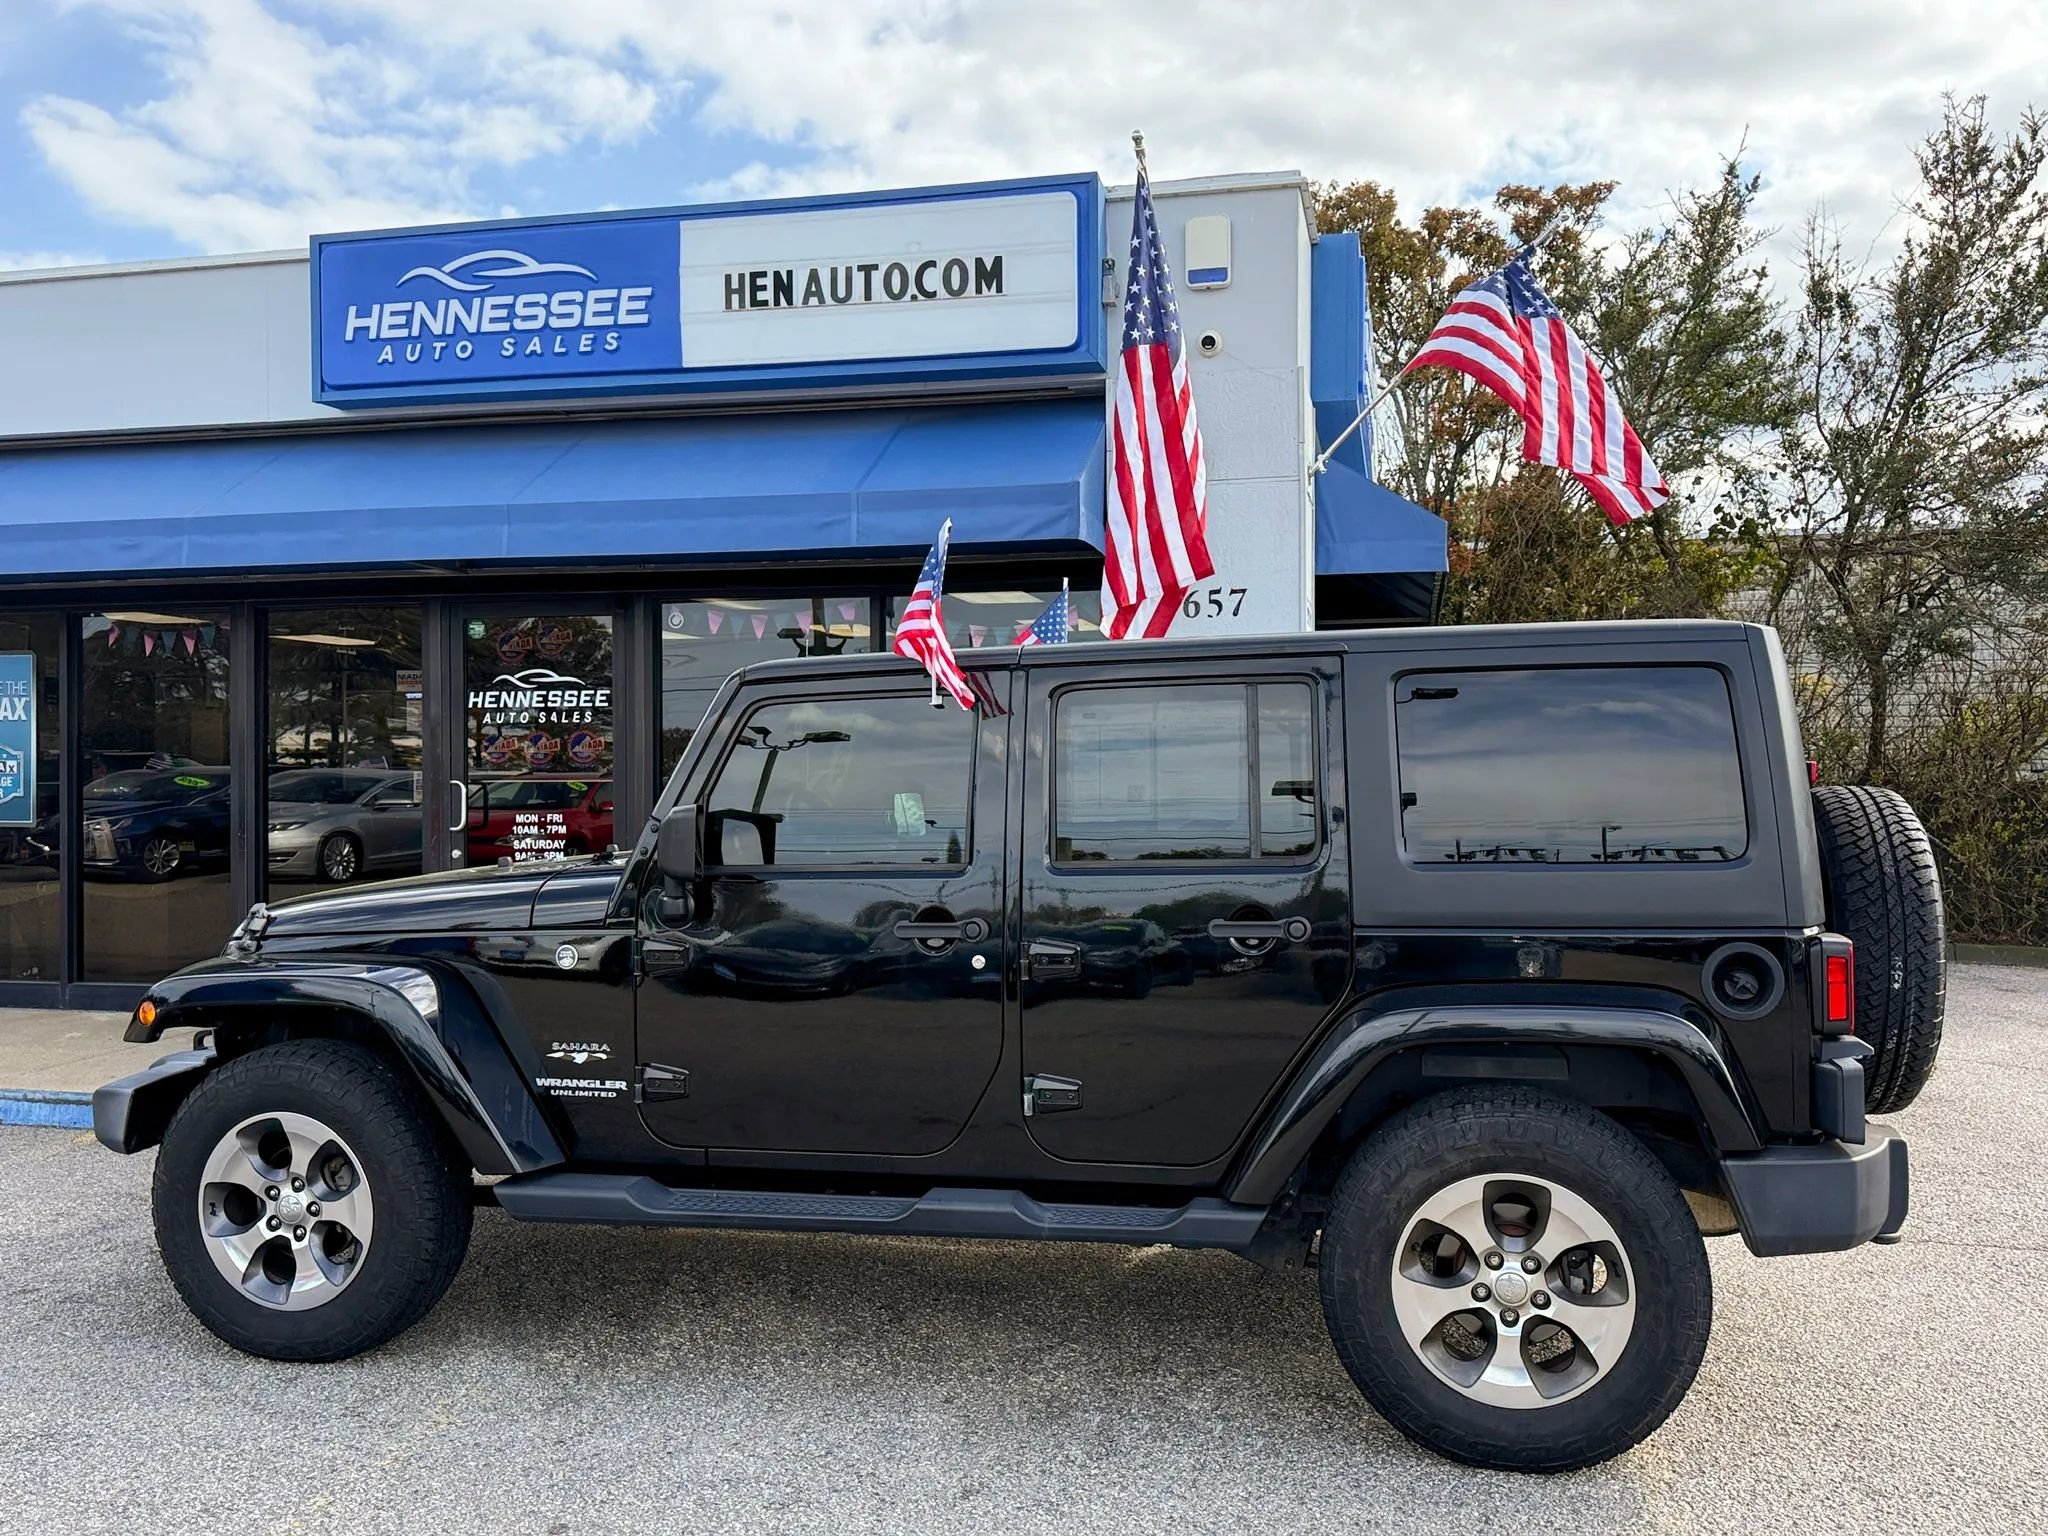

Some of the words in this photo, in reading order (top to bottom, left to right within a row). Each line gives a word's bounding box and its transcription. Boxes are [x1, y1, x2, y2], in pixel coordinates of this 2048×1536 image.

[723, 255, 1004, 310] HENAUTO.COM
[344, 286, 653, 342] HENNESSEE
[377, 339, 474, 364] AUTO
[500, 331, 621, 357] SALES
[1182, 586, 1248, 619] 657
[5, 680, 28, 696] THE
[468, 689, 611, 709] HENNESSEE
[482, 711, 529, 724] AUTO
[538, 711, 593, 724] SALES
[515, 813, 539, 824] MON
[546, 813, 563, 824] FRI
[512, 825, 538, 835] 10AM
[546, 825, 567, 835] 7PM
[513, 839, 566, 850] SATURDAY
[551, 1042, 611, 1052] SAHARA
[535, 1077, 629, 1091] WRANGLER
[550, 1089, 617, 1098] UNLIMITED
